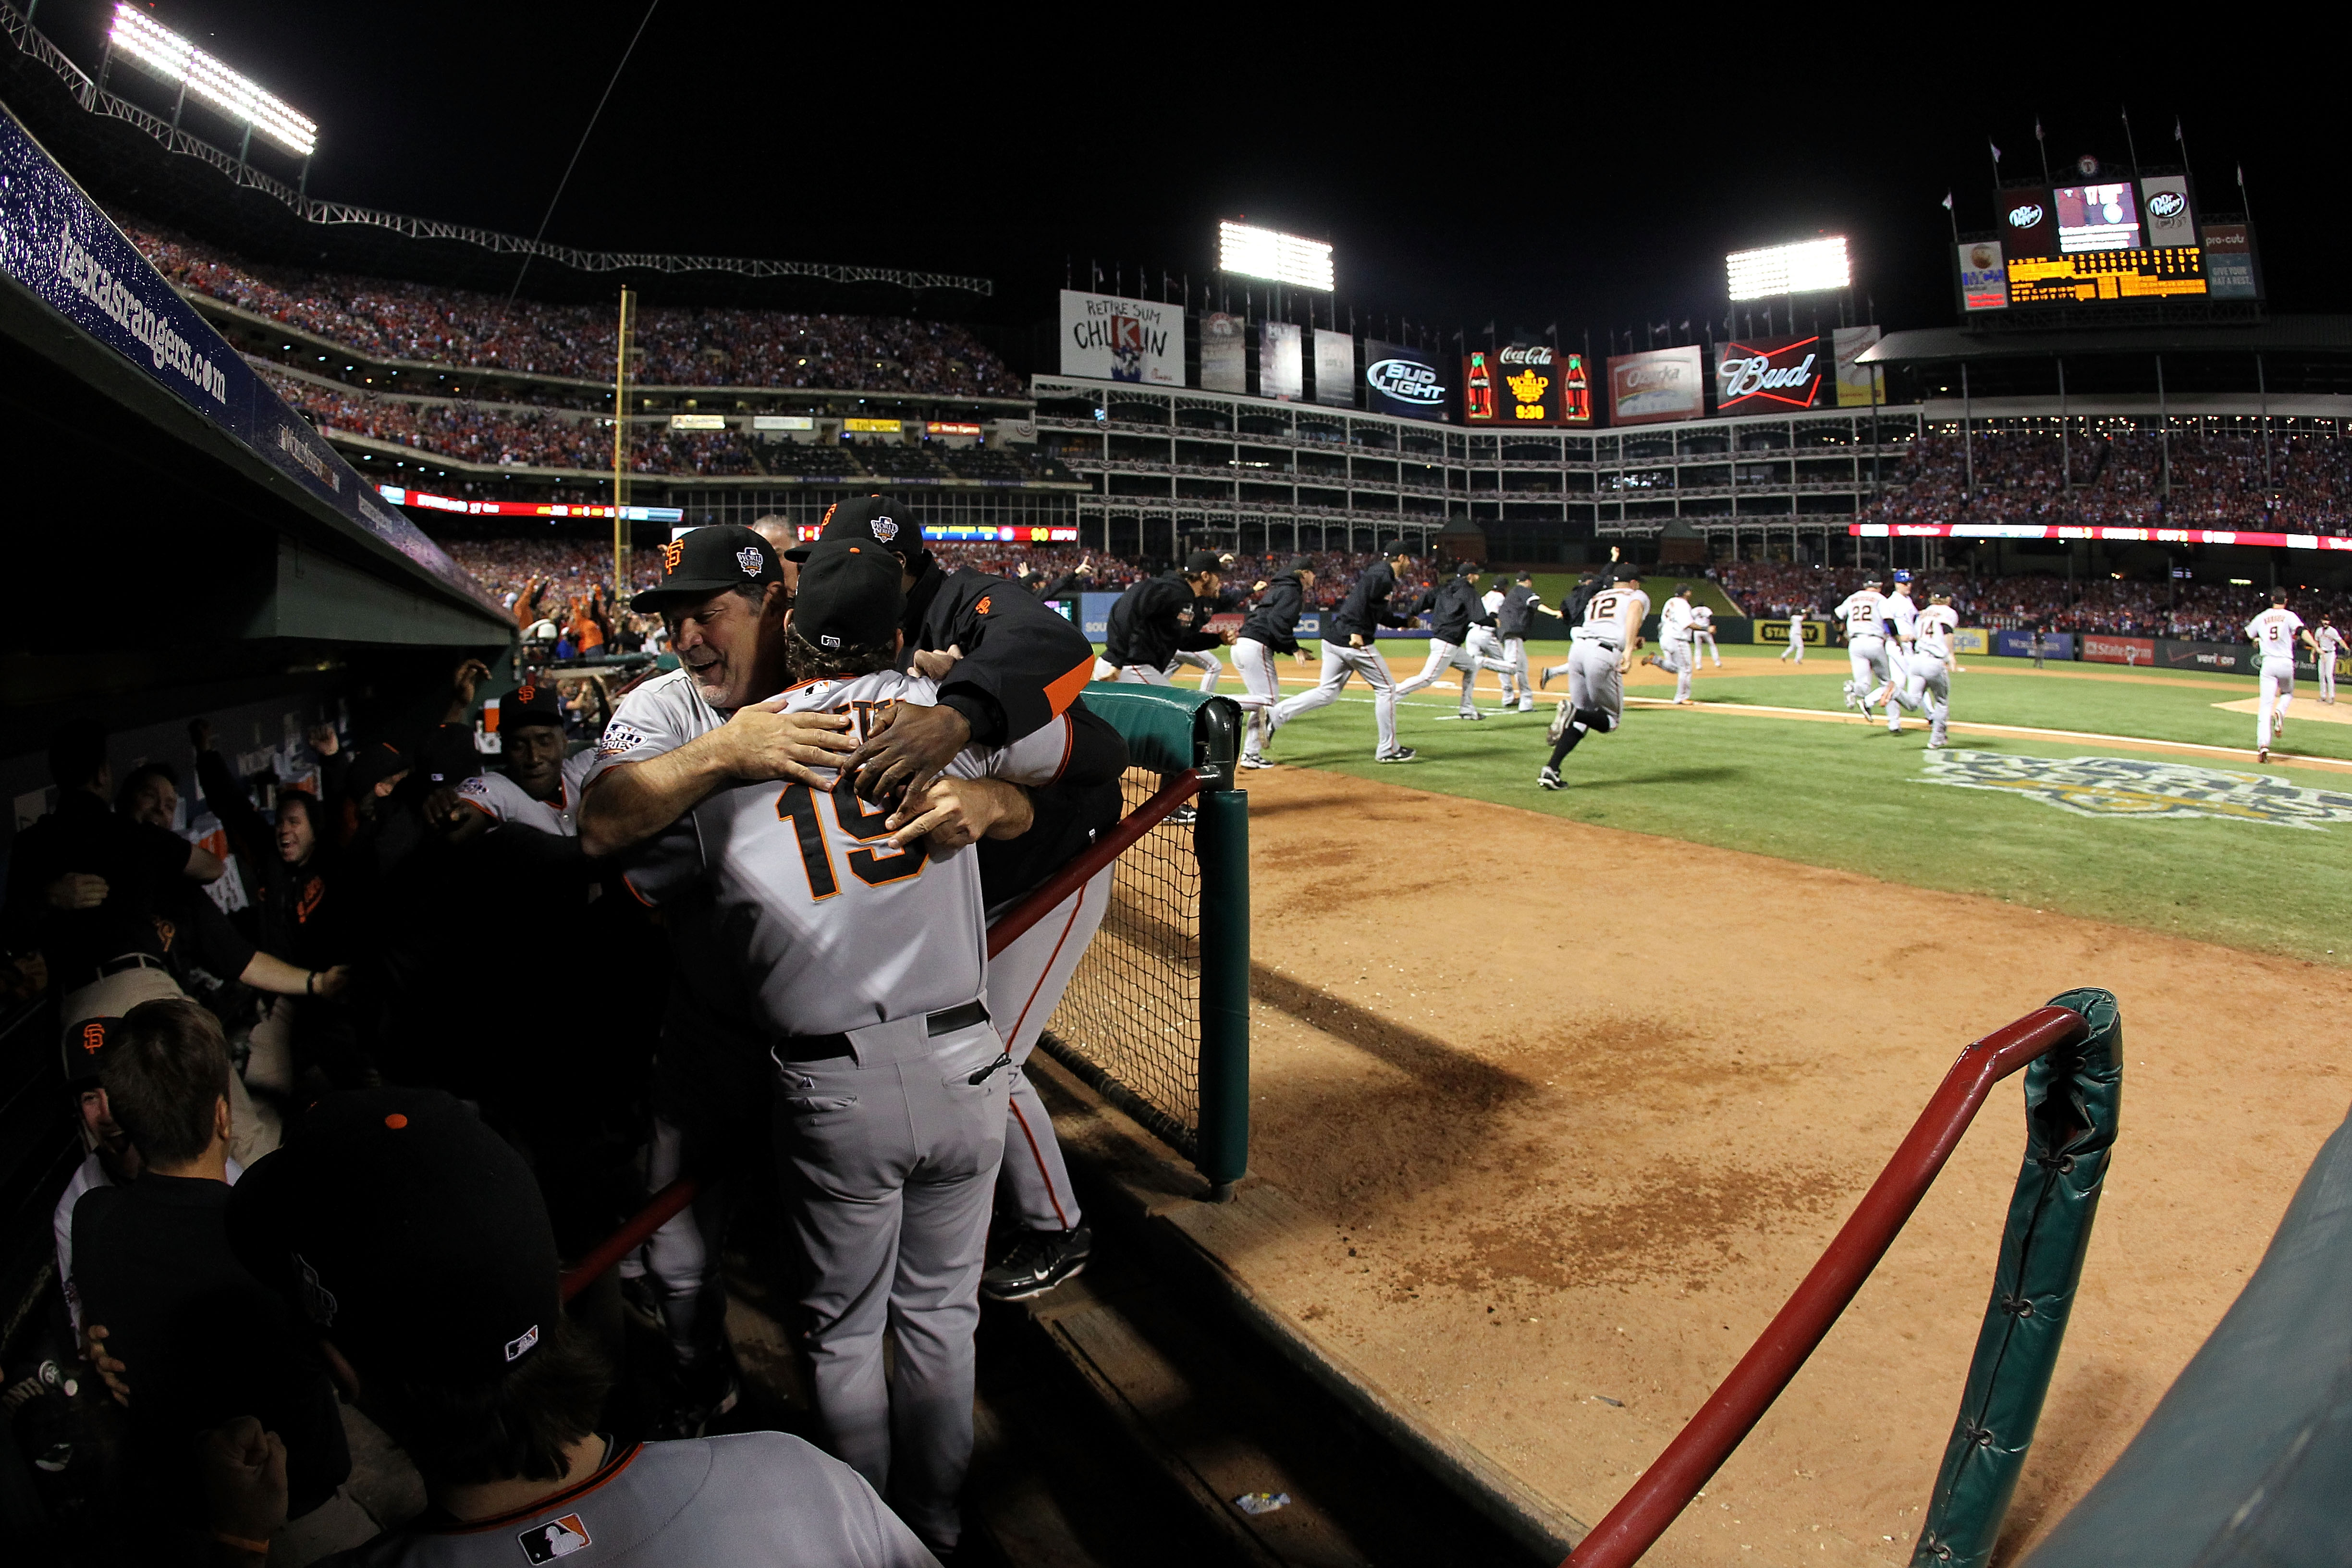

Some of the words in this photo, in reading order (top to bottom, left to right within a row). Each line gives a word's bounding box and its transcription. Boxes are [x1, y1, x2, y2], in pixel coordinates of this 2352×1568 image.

[60, 220, 226, 405] texasrangers.com
[1086, 300, 1128, 315] RETIRE
[1133, 304, 1161, 324] SUM
[1385, 364, 1436, 384] BUD
[1506, 376, 1549, 388] WORLD
[1718, 353, 1816, 396] Bud
[1376, 375, 1446, 399] LIGHT
[1515, 404, 1544, 419] 9:30
[873, 521, 897, 532] WORLD
[1030, 527, 1049, 541] 90
[1050, 529, 1078, 541] MPH
[665, 538, 685, 575] SF
[739, 554, 763, 563] WORLD
[1591, 597, 1617, 620] 12
[1852, 605, 1872, 622] 22
[2269, 626, 2278, 640] 9
[518, 685, 536, 704] SF
[603, 731, 648, 746] ORLD
[83, 1023, 105, 1055] SF
